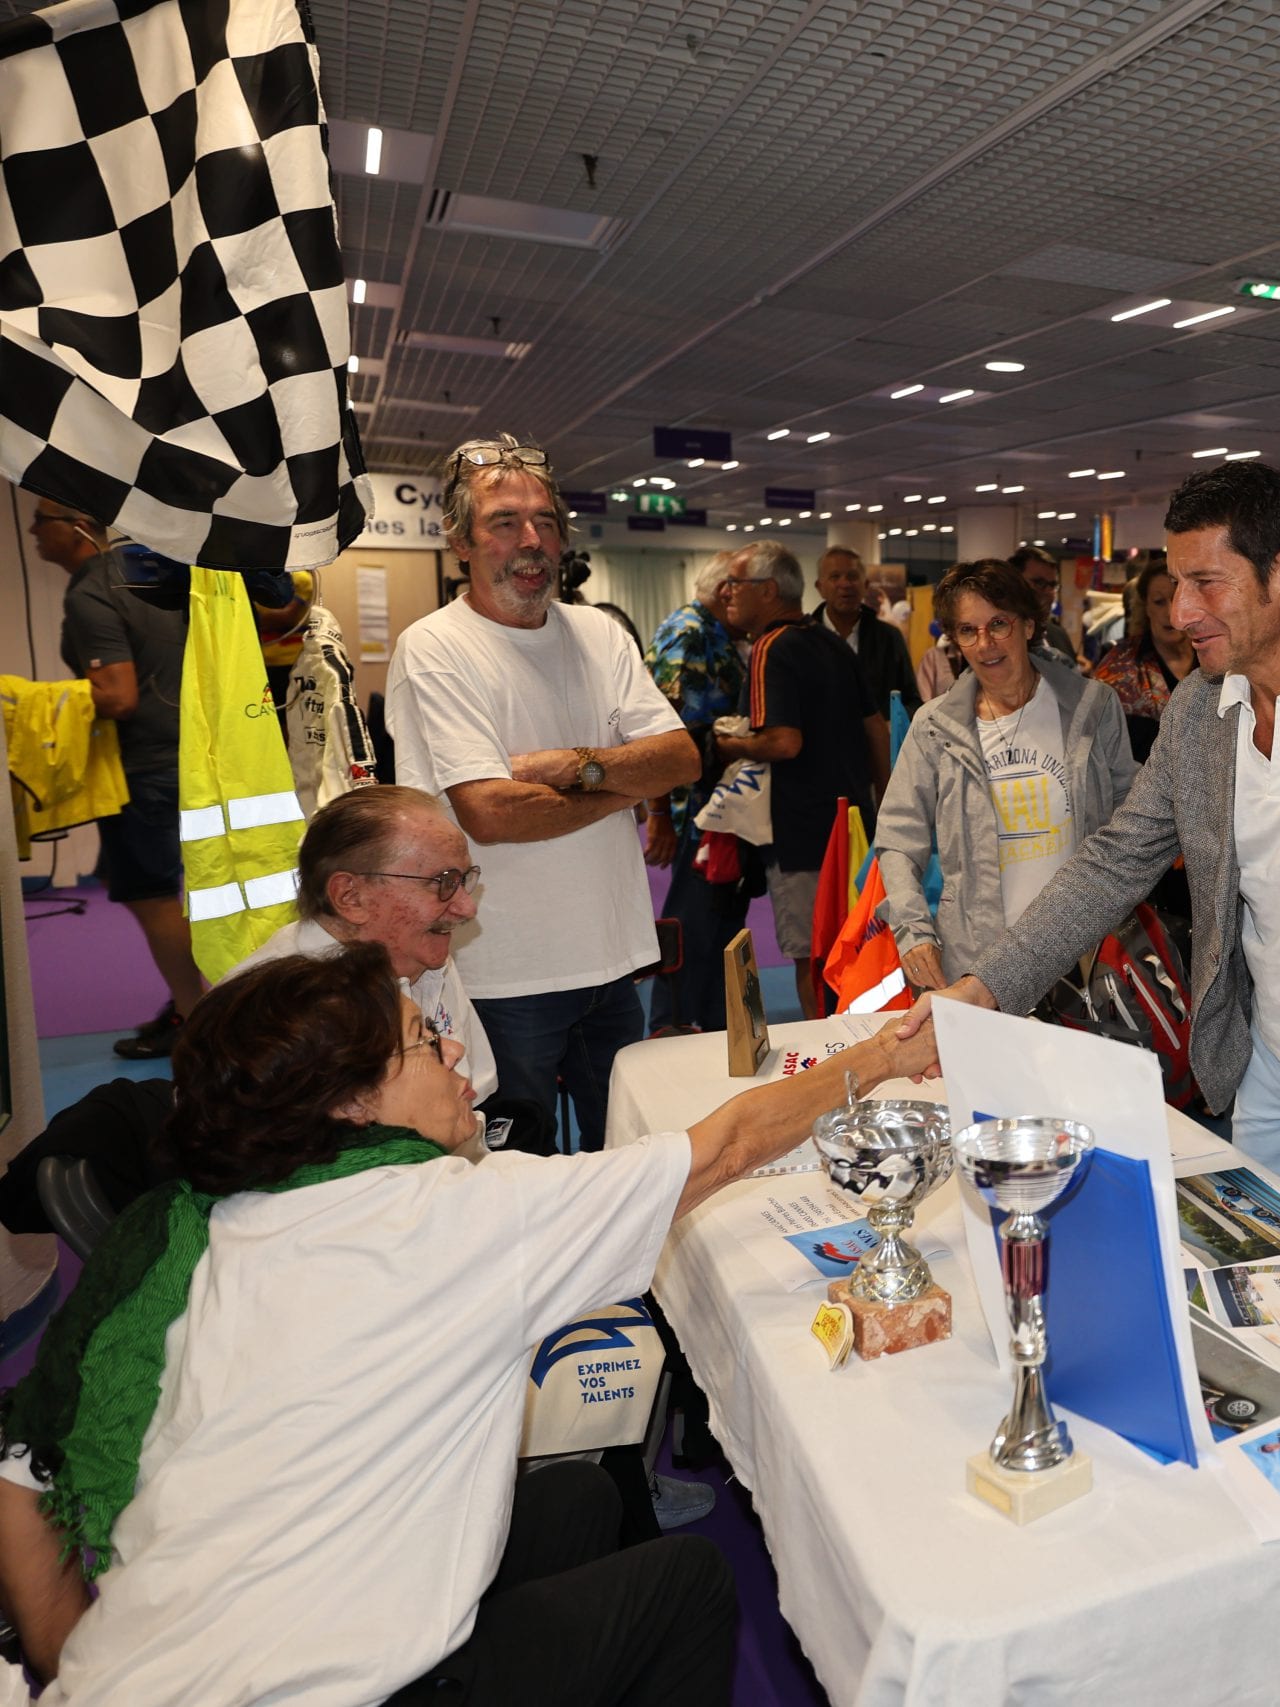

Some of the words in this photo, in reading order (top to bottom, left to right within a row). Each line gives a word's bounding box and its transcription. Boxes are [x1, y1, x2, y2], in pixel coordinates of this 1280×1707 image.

[985, 748, 1037, 774] ARIZONA
[783, 1052, 799, 1076] ASAC
[577, 1358, 641, 1376] EXPRIMEZ
[580, 1377, 606, 1389] VOS
[581, 1387, 635, 1404] TALENTS
